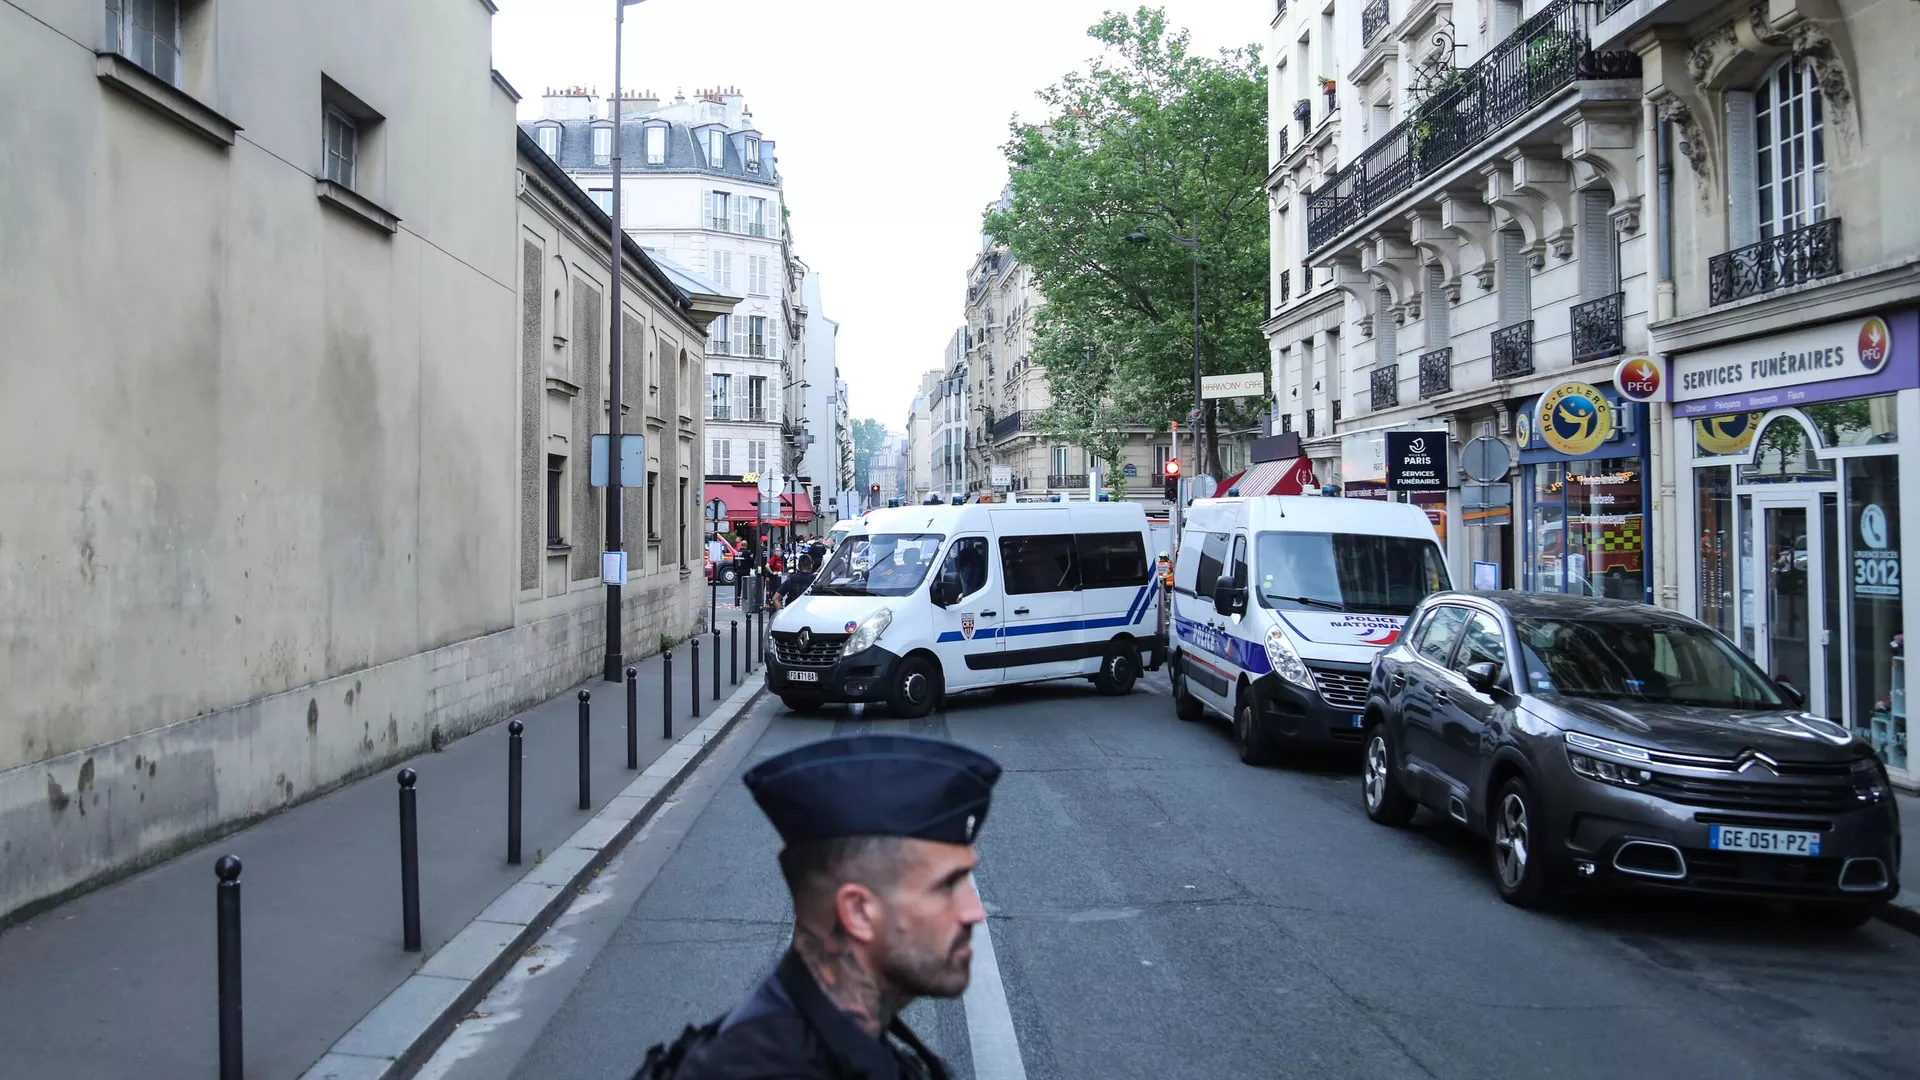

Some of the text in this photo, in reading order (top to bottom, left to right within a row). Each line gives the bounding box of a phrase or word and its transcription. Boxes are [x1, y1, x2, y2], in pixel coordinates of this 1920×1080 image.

[1862, 347, 1881, 362] PFG
[1683, 346, 1843, 390] SERVICES FUNÉRAIRES
[1203, 381, 1241, 392] HARMONY
[1628, 381, 1653, 392] PFG
[1787, 390, 1805, 400] Fleurs
[1542, 402, 1553, 432] ROC
[1556, 386, 1606, 412] ECLERC
[1404, 456, 1431, 465] PARIS
[1397, 477, 1440, 485] FUNÉRAIRES
[1854, 559, 1900, 585] 3012
[1344, 616, 1399, 624] POLICE
[1723, 830, 1808, 852] GE-051-PZ
